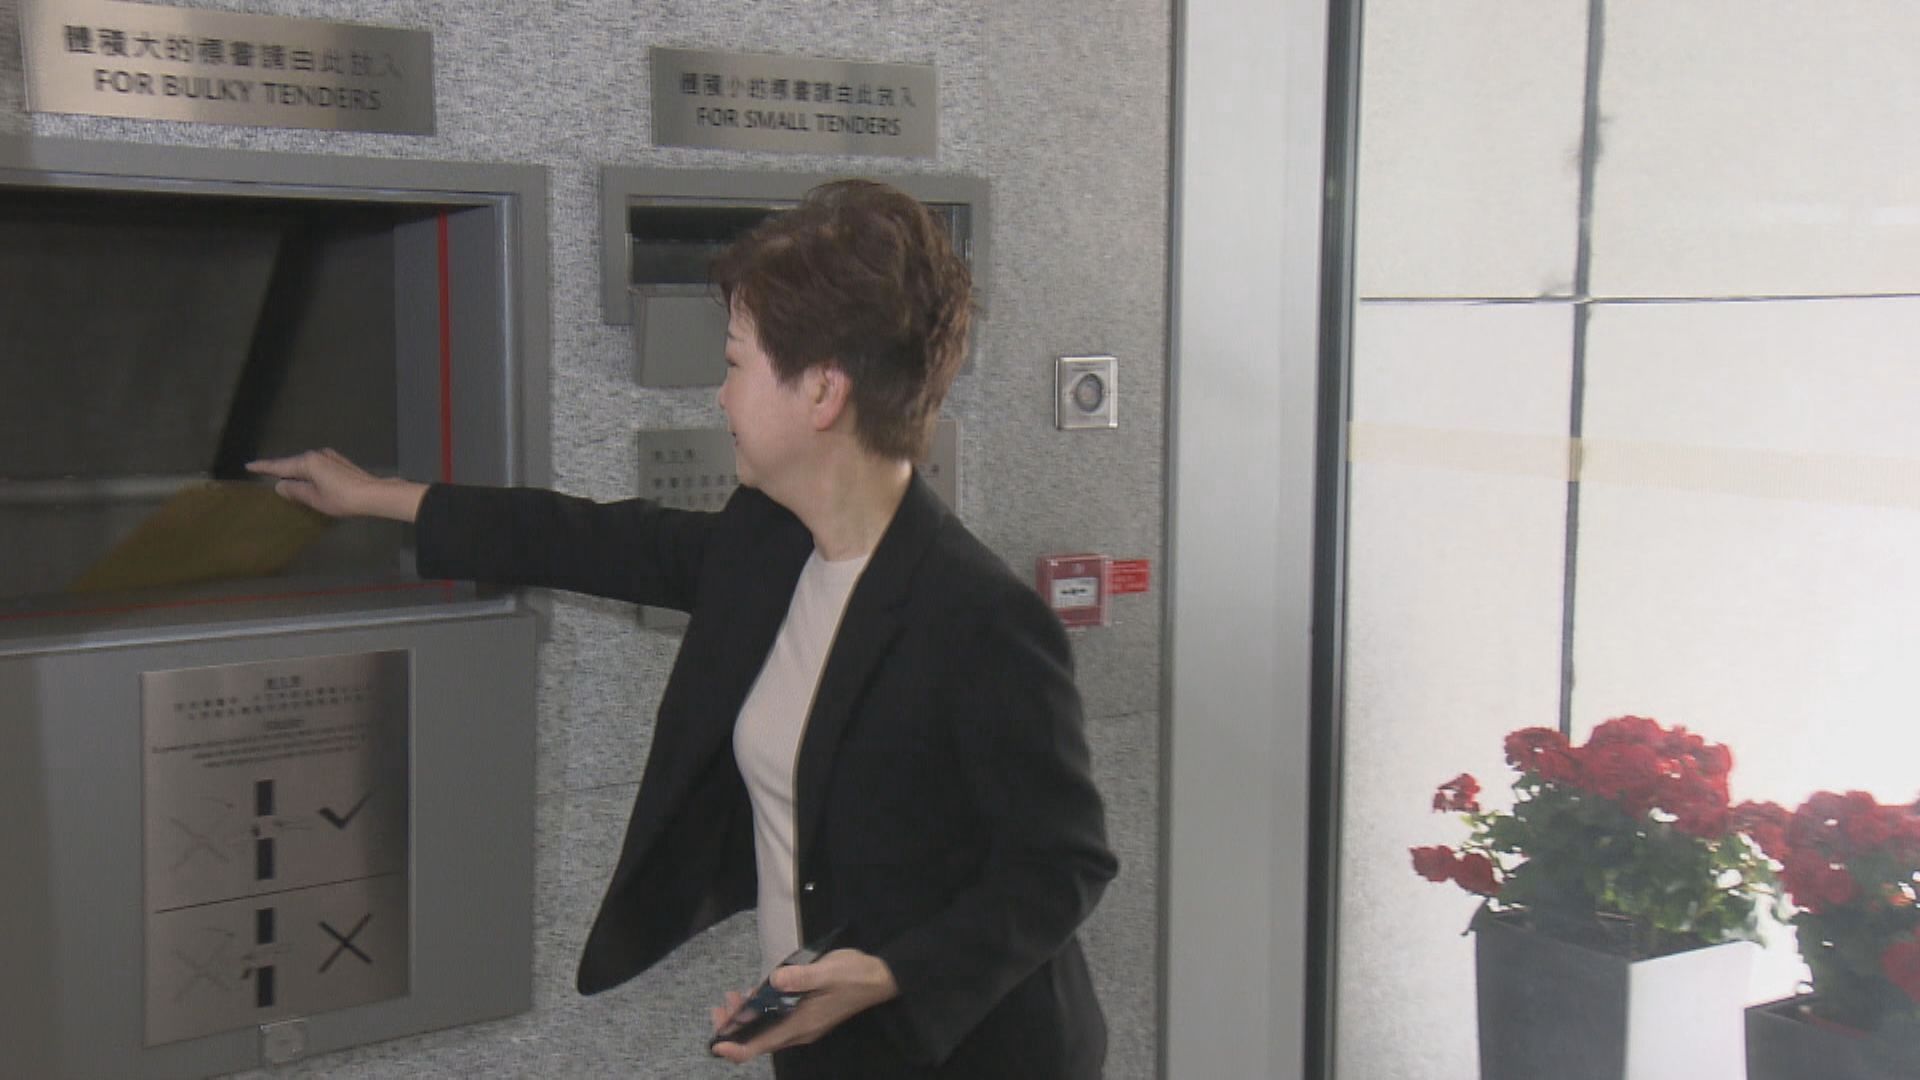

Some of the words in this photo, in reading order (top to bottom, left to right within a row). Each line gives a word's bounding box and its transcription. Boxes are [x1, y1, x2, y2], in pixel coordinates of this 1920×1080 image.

[95, 69, 154, 95] FOR
[162, 74, 251, 103] BULKY
[261, 82, 382, 111] TENDERS
[696, 106, 739, 128] FOR
[744, 109, 809, 132] SMALL
[815, 113, 901, 136] TENDERS
